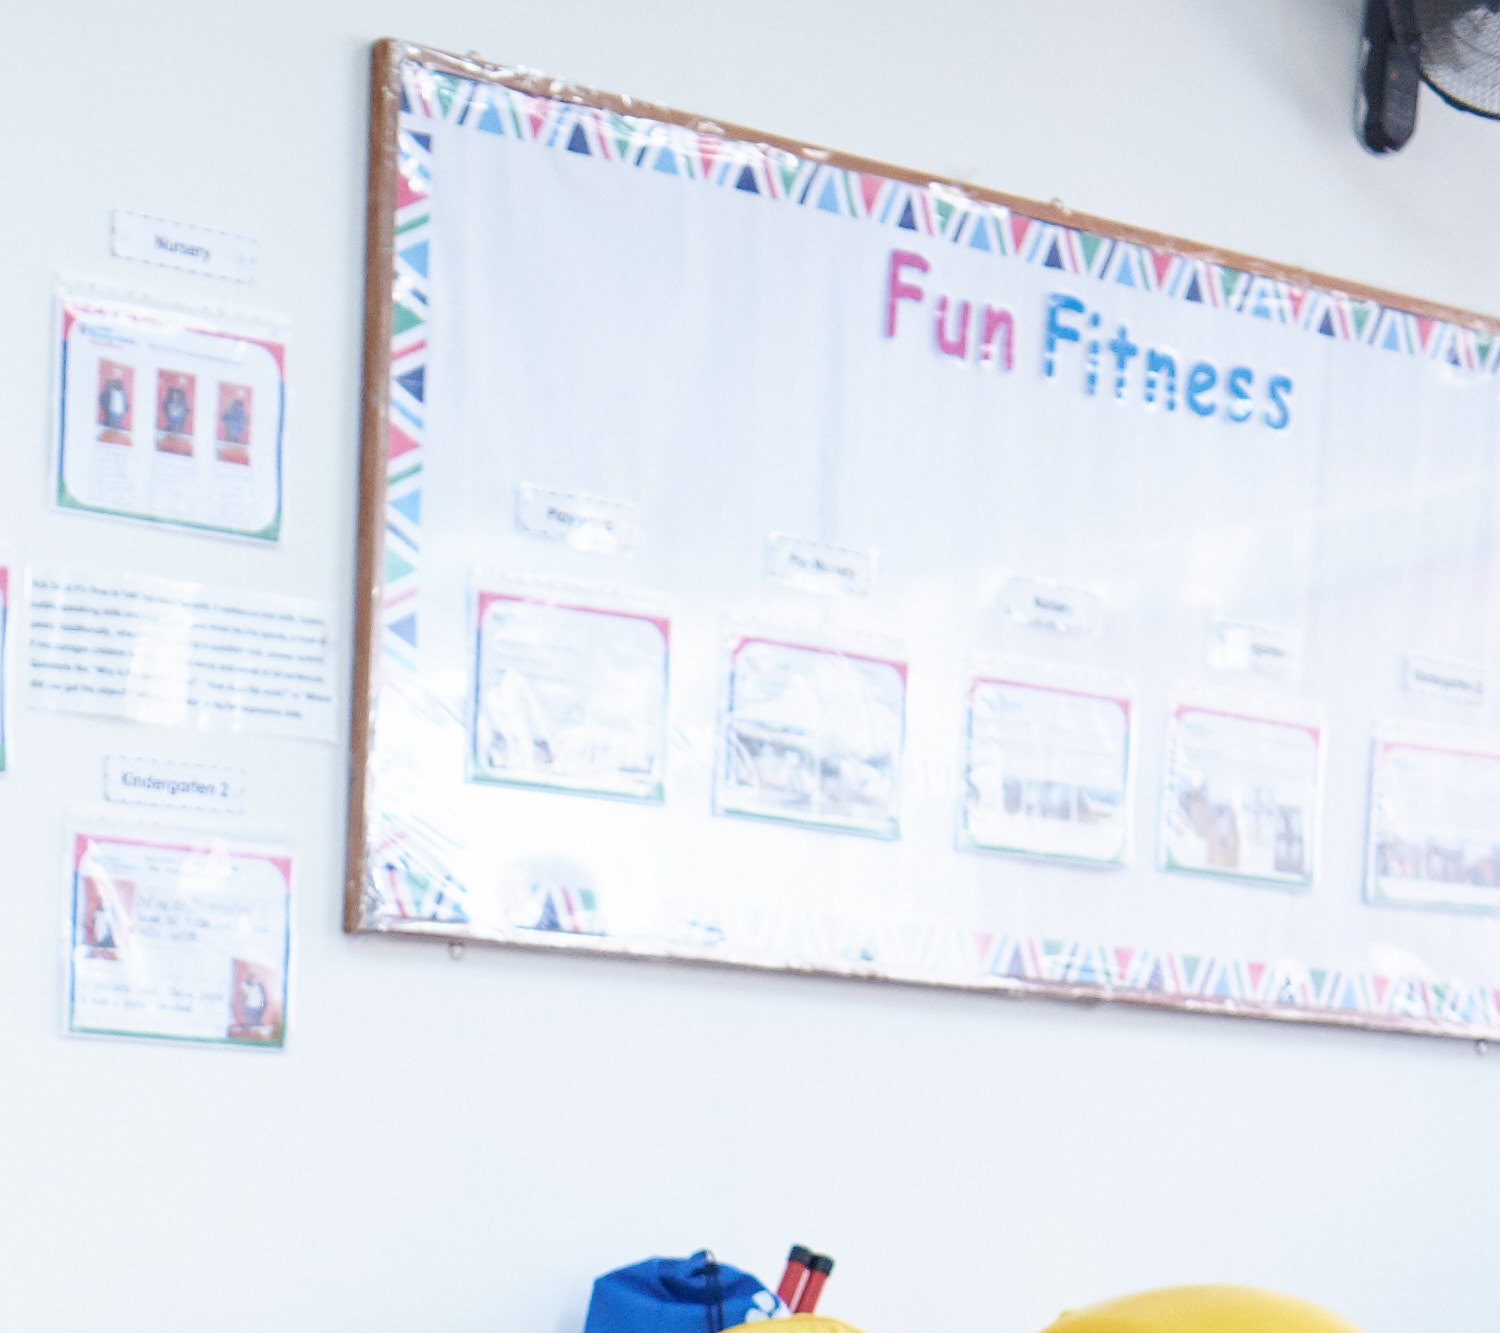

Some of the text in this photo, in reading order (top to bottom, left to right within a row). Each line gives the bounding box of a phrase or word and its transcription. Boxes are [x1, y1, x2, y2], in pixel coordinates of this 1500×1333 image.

[154, 234, 210, 263] Nursery
[885, 248, 1294, 431] Fun Fitness
[120, 771, 229, 798] Kindergarten 2
